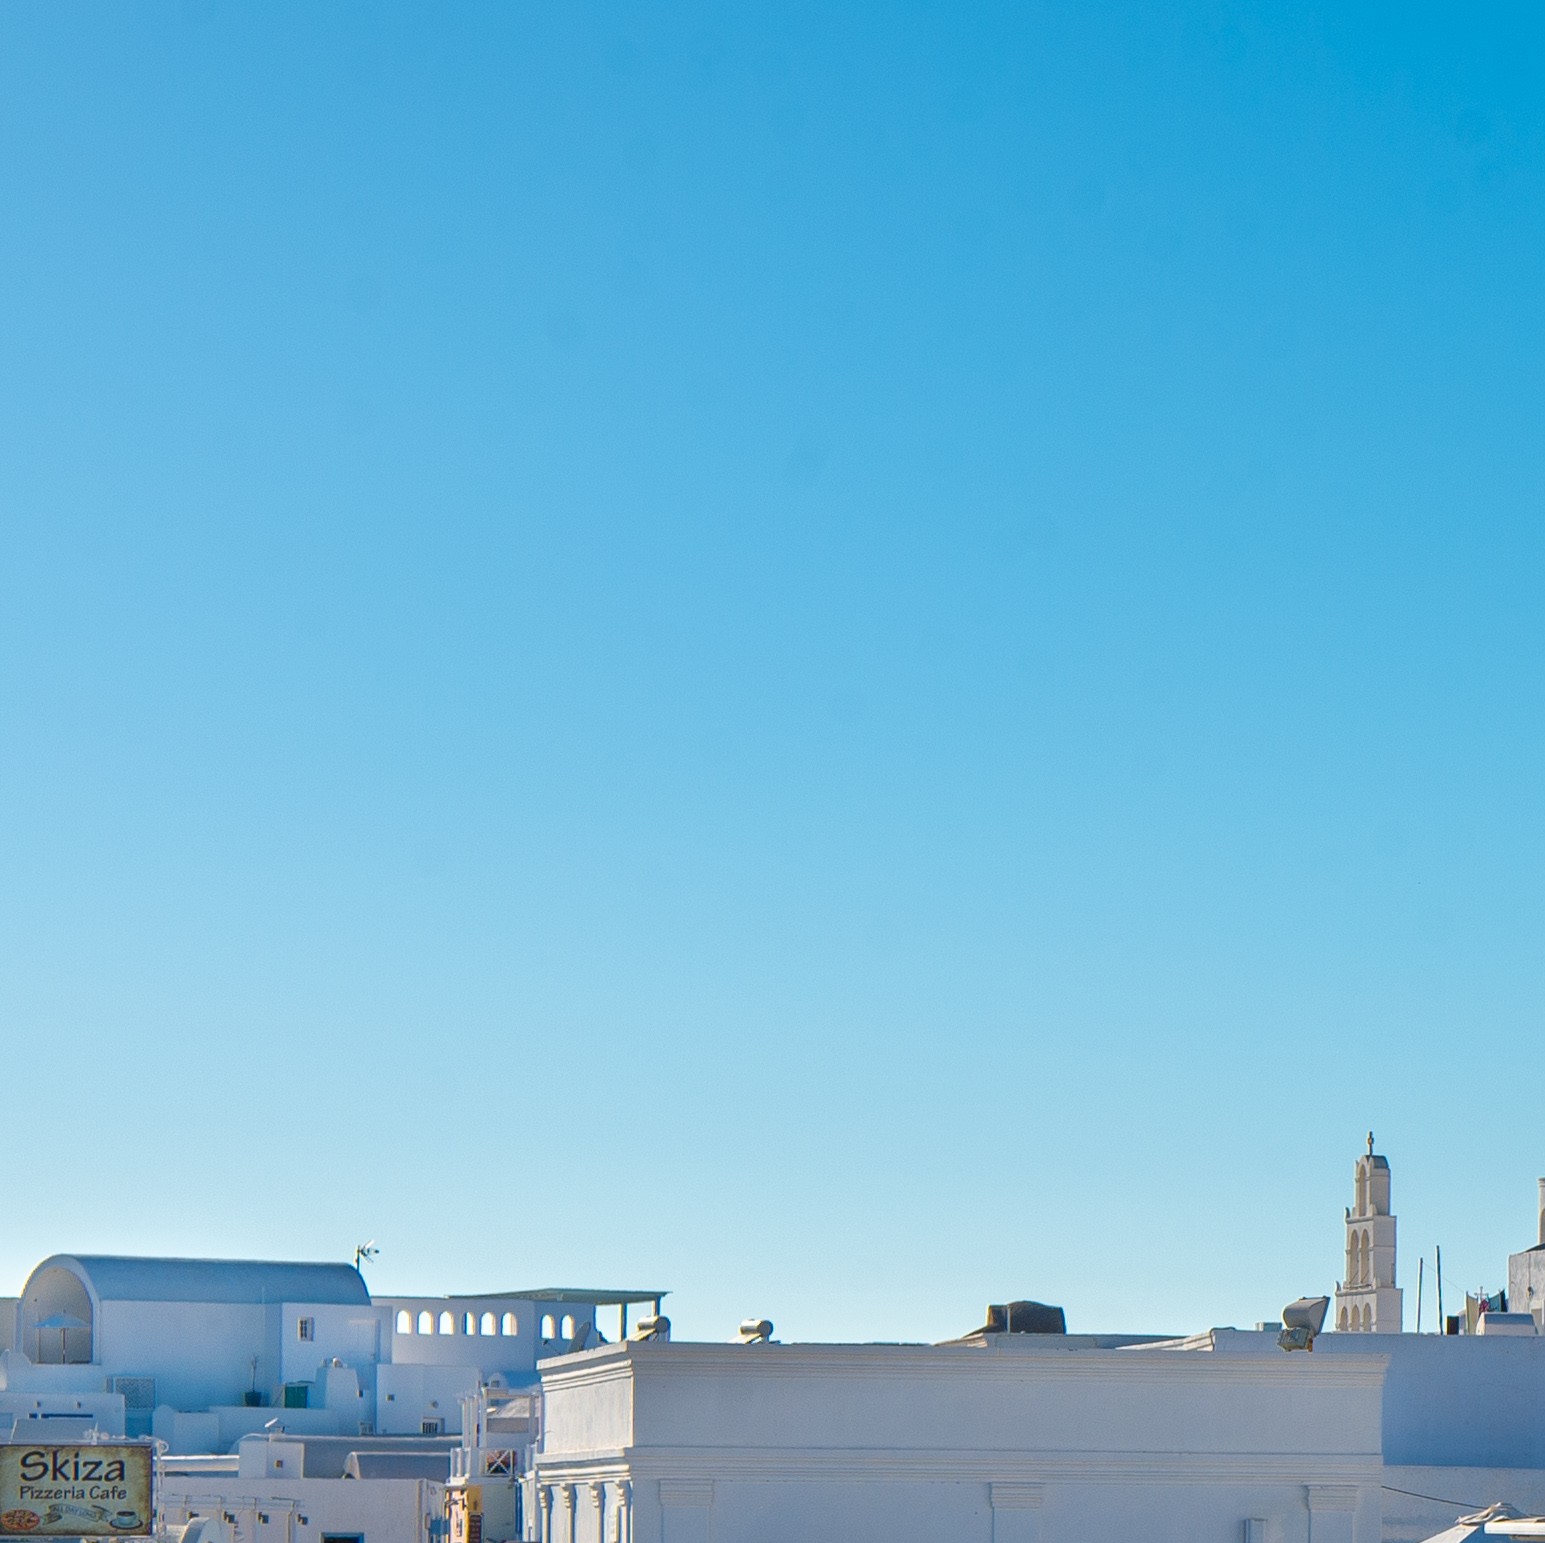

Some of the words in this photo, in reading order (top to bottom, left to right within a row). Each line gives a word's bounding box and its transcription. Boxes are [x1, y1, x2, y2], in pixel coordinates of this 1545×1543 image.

[20, 1449, 125, 1481] Skiza
[20, 1486, 84, 1500] Pizzeria
[89, 1486, 127, 1500] Cafe
